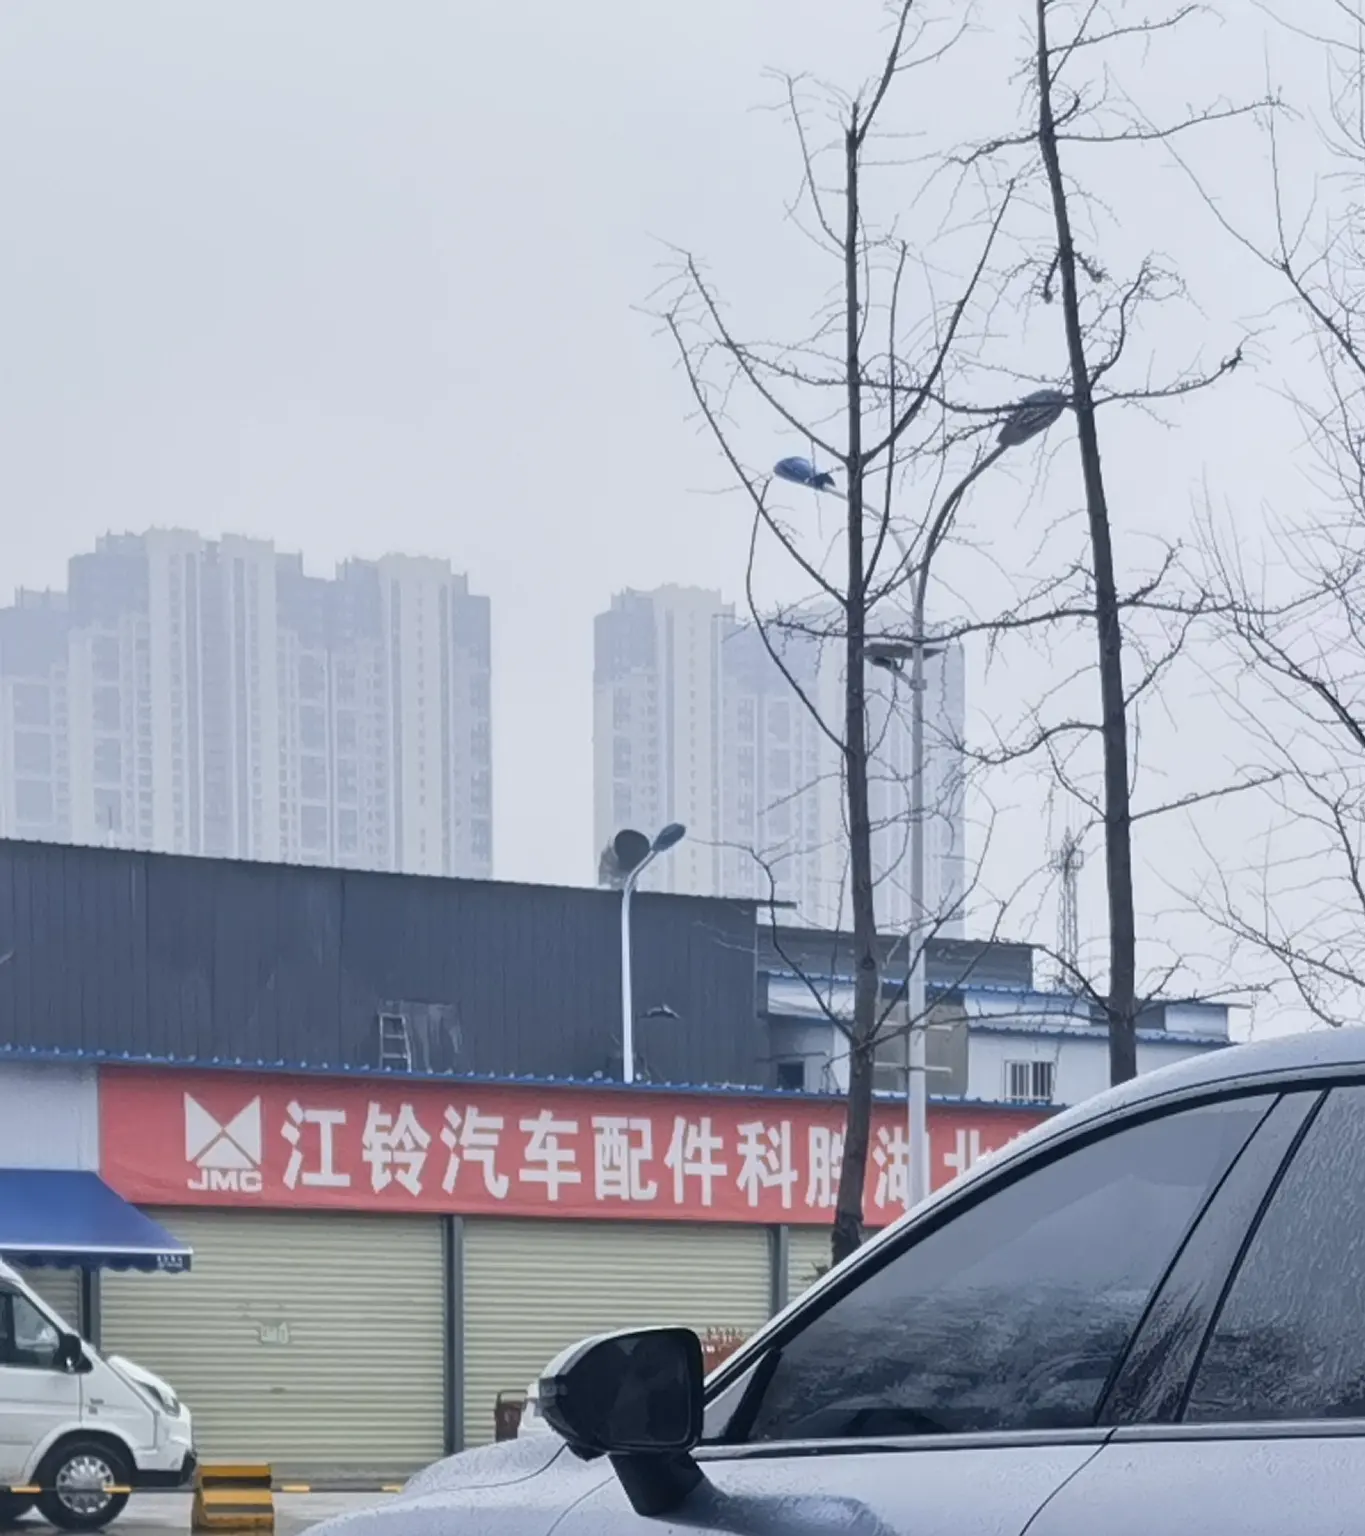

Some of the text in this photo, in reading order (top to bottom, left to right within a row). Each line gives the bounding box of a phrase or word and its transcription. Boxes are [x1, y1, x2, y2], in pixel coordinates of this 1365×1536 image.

[187, 1169, 263, 1193] JMC
[280, 1099, 1026, 1210] 江铃汽车配件科胜湖北
